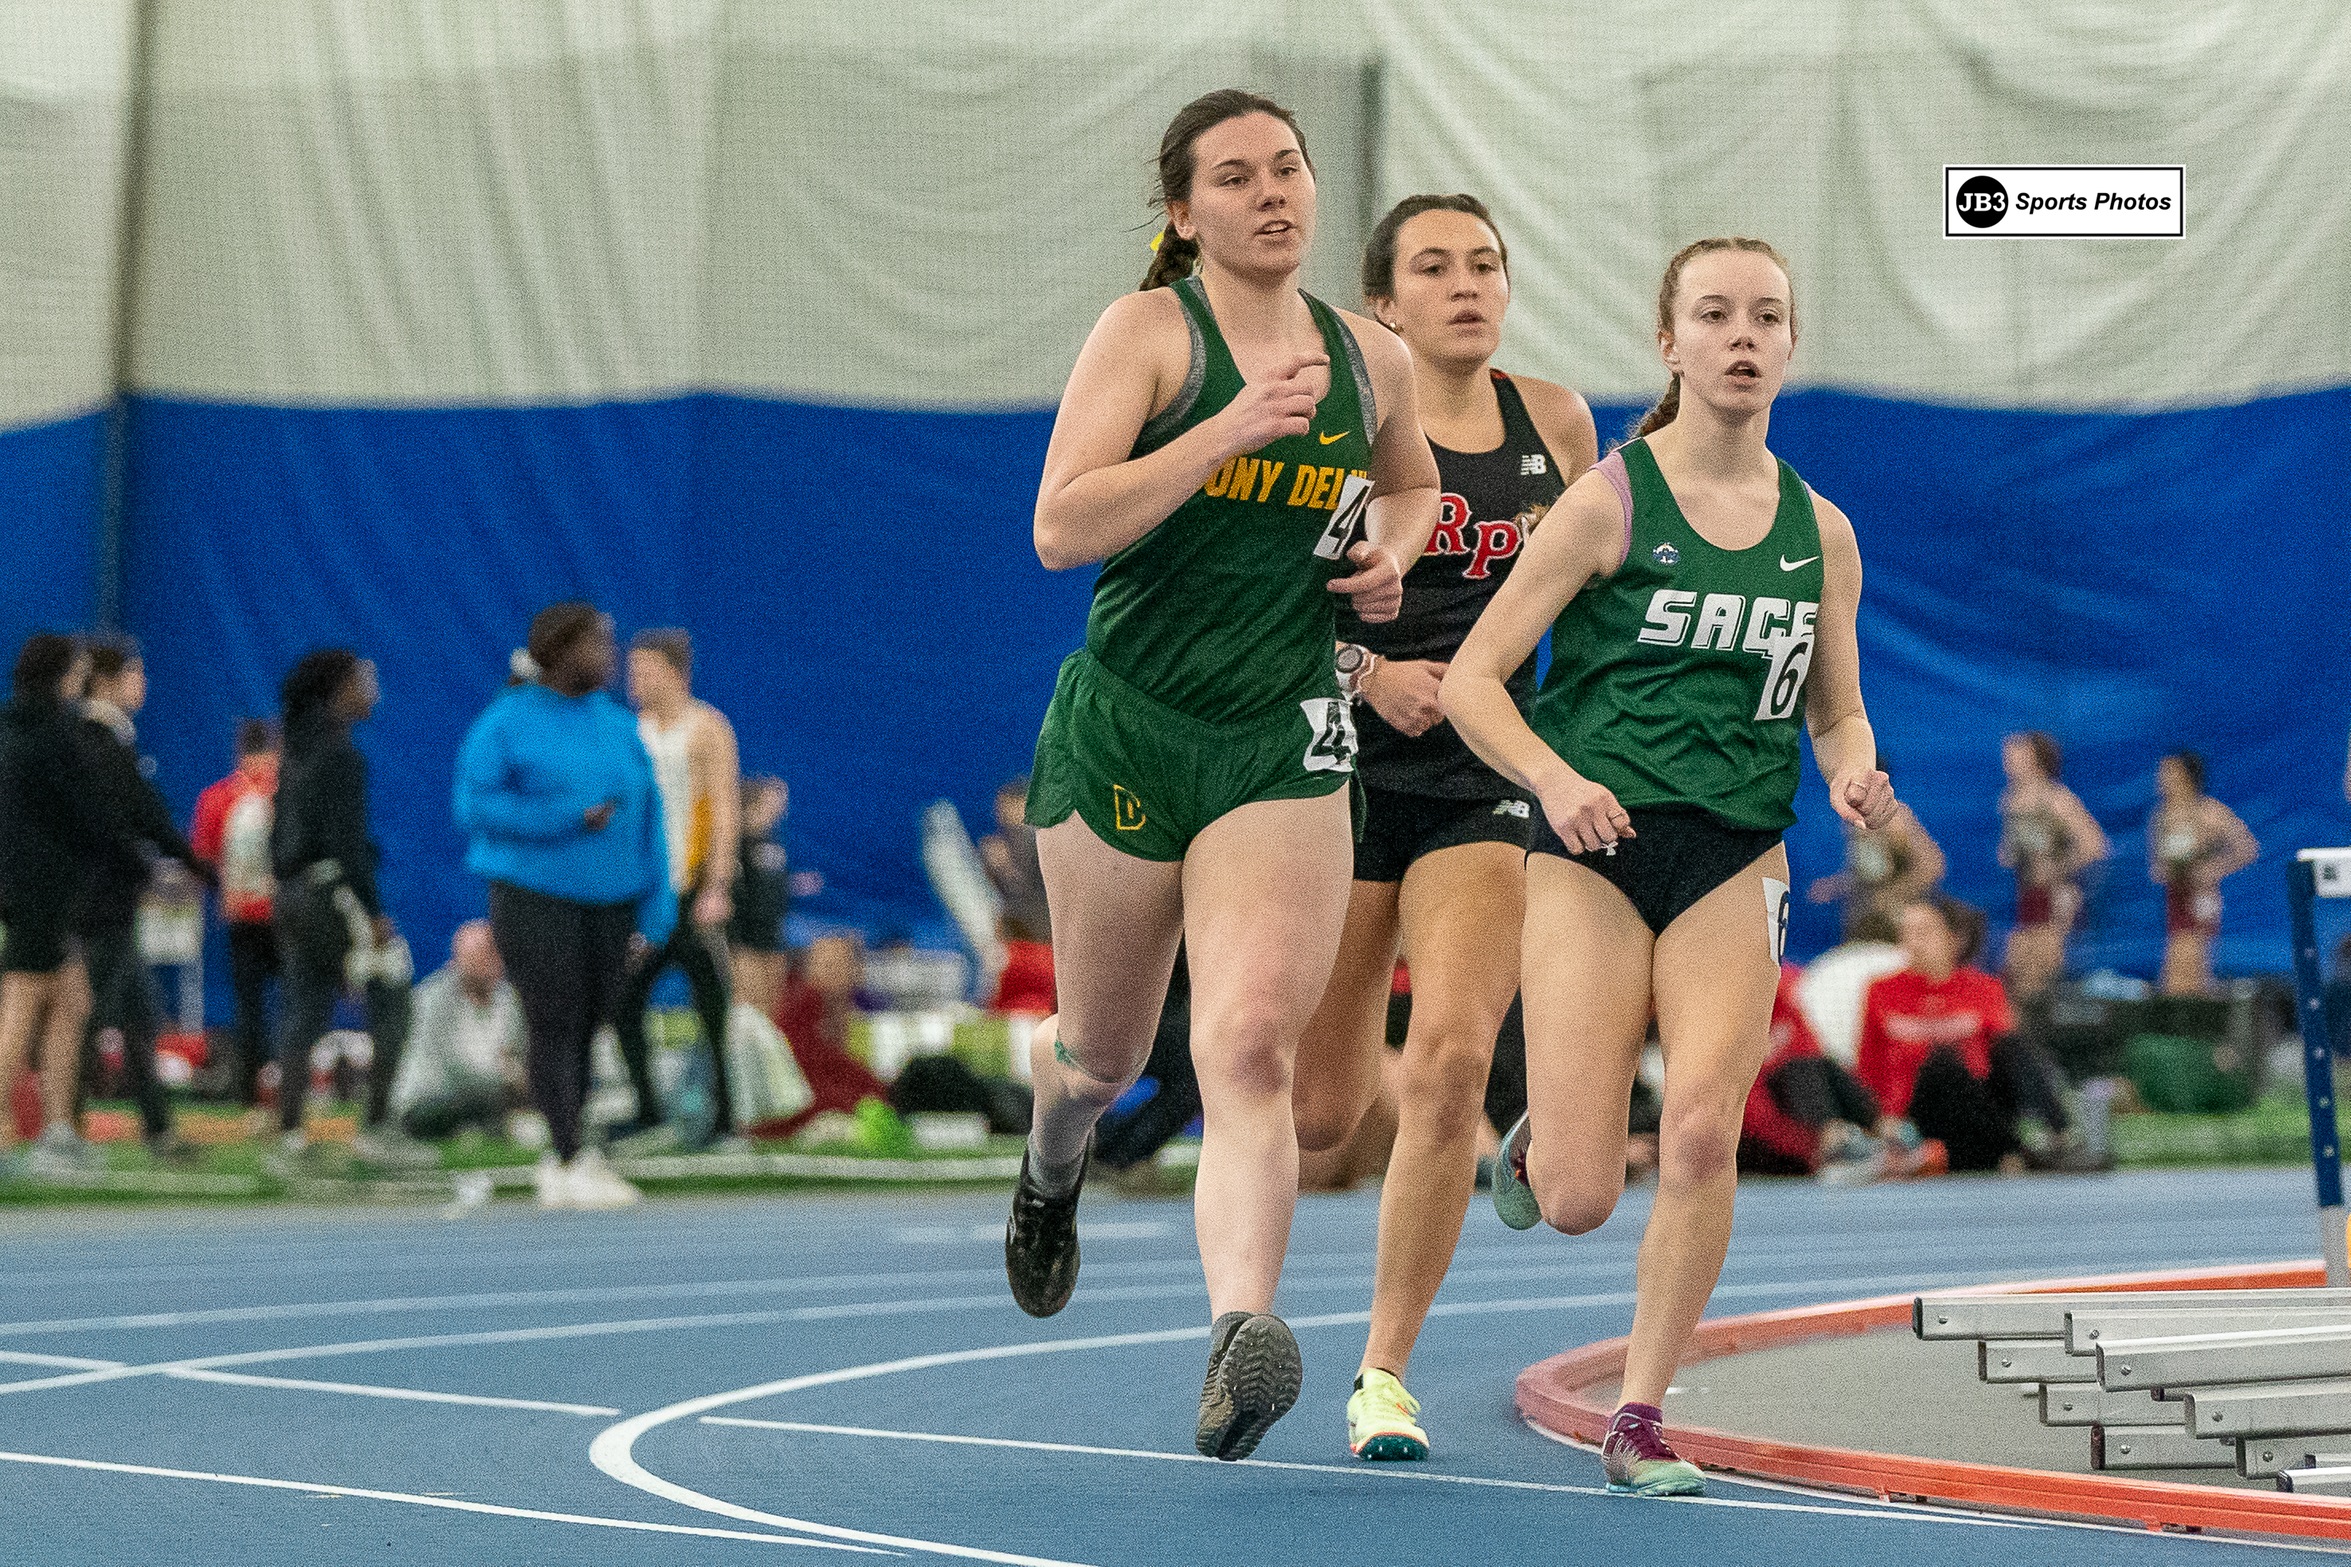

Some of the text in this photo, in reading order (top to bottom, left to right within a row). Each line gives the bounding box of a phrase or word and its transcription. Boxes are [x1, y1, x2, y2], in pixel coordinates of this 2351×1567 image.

[1287, 464, 1368, 511] DEL
[1328, 484, 1371, 555] 4
[1770, 641, 1809, 716] 6
